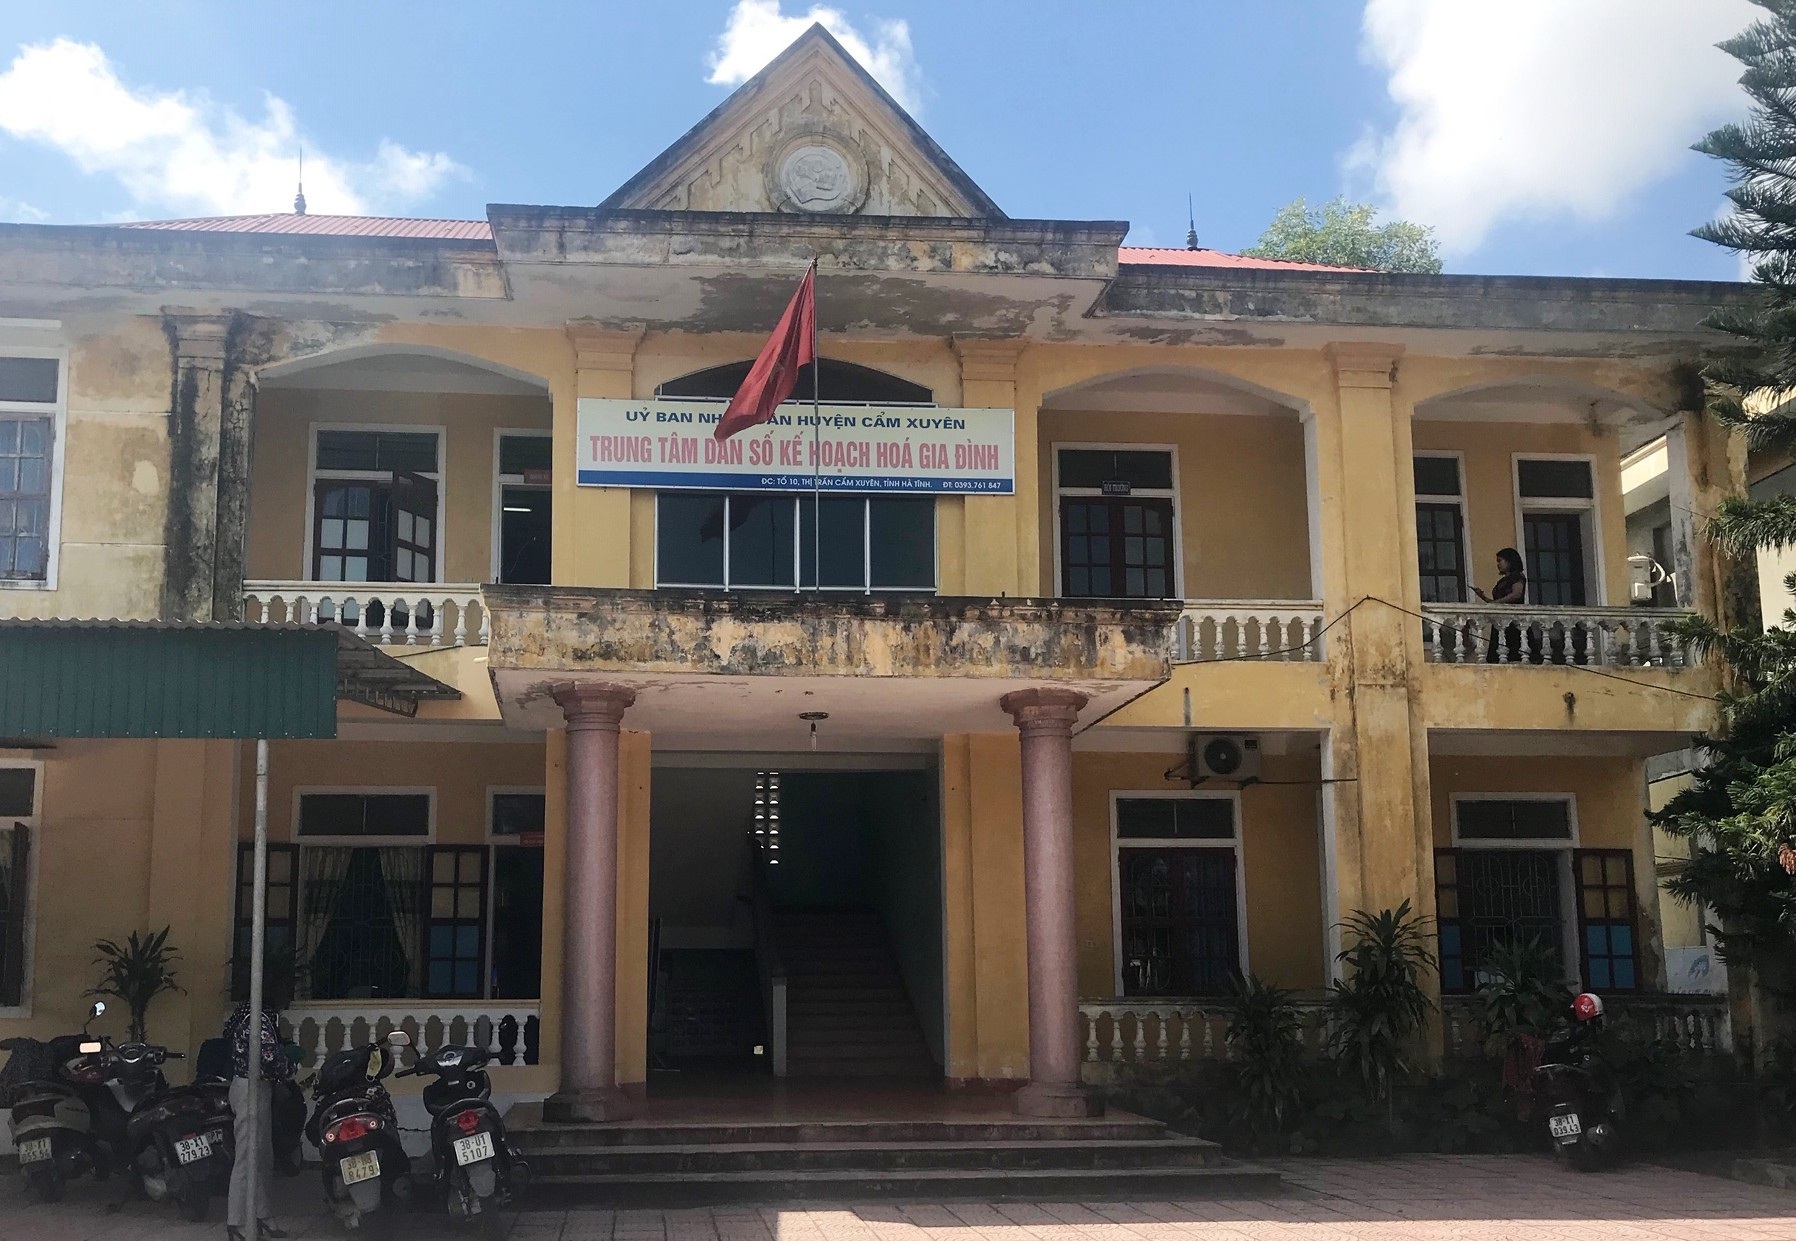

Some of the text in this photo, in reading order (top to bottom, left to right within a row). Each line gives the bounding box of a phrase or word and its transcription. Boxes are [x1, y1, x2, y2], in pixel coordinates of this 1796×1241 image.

[626, 407, 650, 421] UỶ
[656, 412, 692, 423] BAN
[797, 414, 856, 429] HUYỆN
[862, 411, 901, 428] CẨM
[906, 416, 965, 430] XUYÊN
[590, 435, 652, 463] TRUNG
[658, 432, 698, 464] TÂM
[749, 430, 775, 466] SỐ
[780, 431, 803, 466] KẾ
[809, 440, 870, 473] HOẠCH
[876, 437, 913, 469] HOÁ
[919, 443, 950, 469] GIA
[955, 439, 999, 471] ĐÌNH
[789, 478, 800, 486] 10,
[855, 478, 882, 488] XUYÊN,
[901, 478, 913, 488] HÀ
[954, 481, 986, 489] 0393.761
[988, 481, 1001, 489] 847
[460, 1134, 486, 1151] 38-U1
[180, 1145, 210, 1163] 279.23
[462, 1145, 488, 1162] 5107
[348, 1164, 375, 1181] 8479
